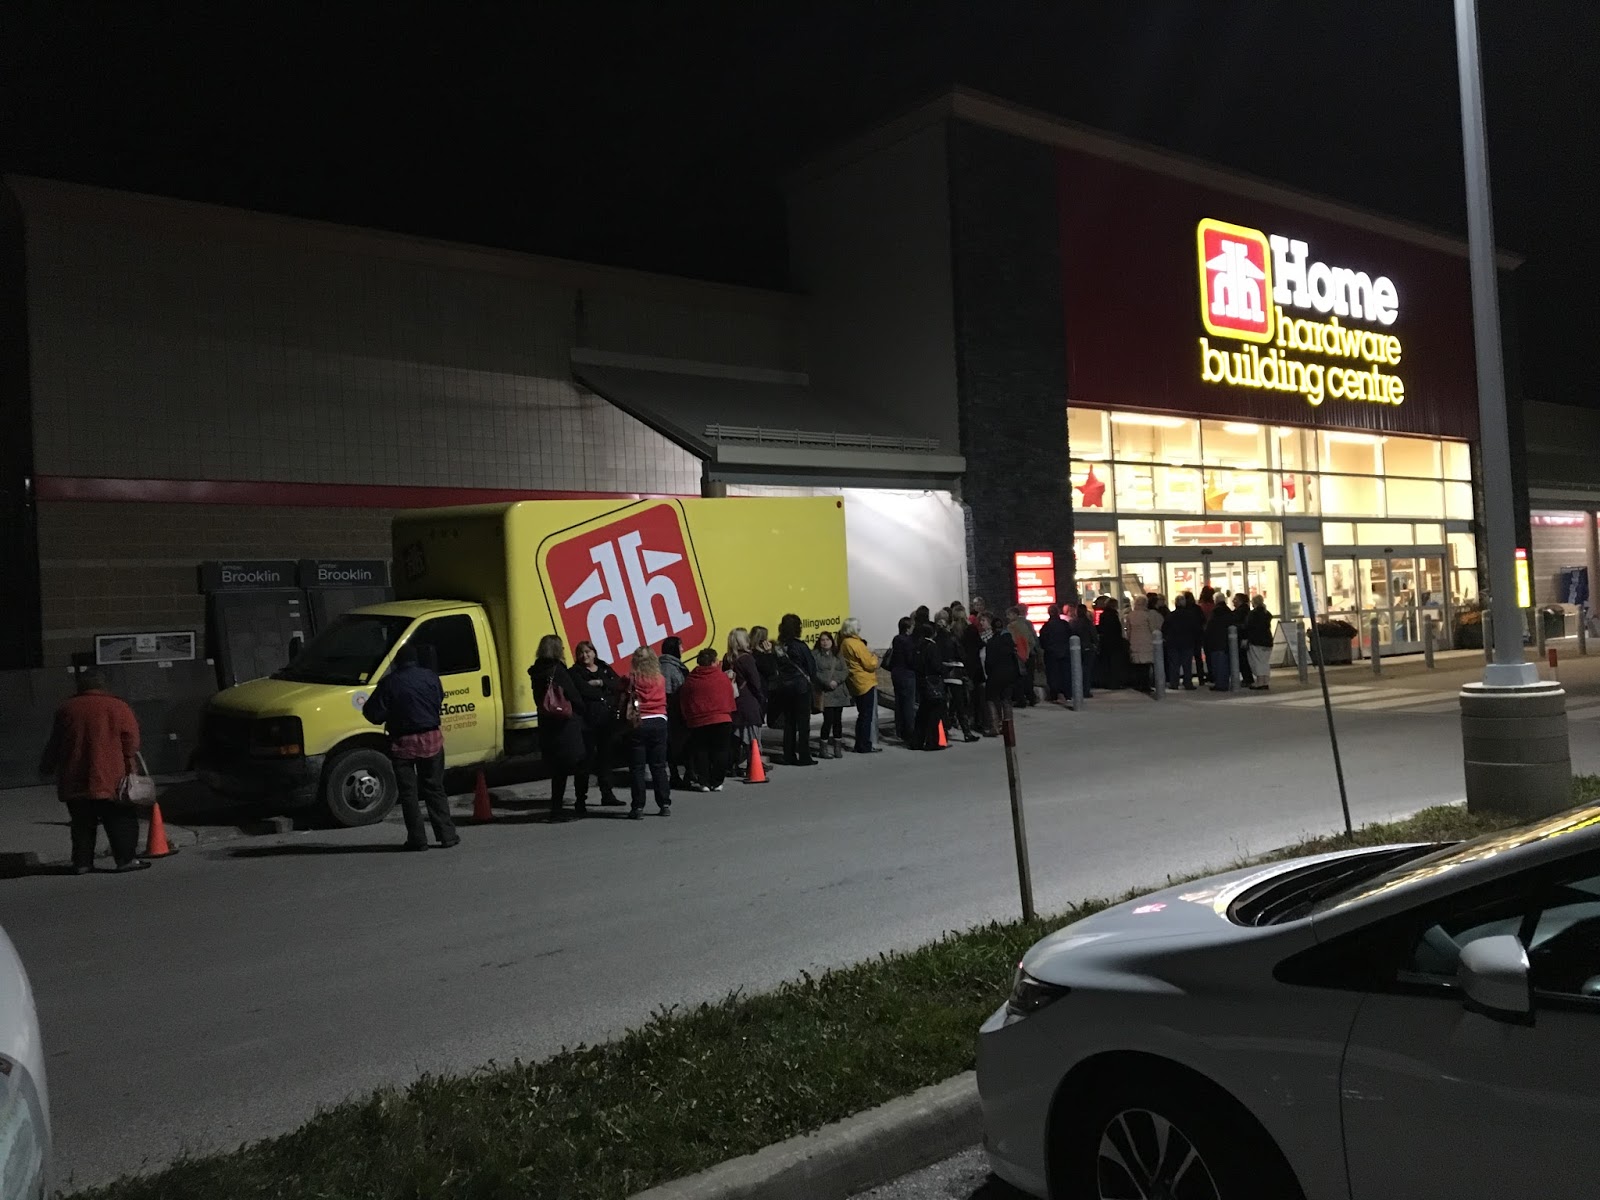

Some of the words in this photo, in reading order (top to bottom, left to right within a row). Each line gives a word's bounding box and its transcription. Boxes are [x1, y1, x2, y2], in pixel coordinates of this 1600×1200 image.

[1270, 234, 1399, 325] Home
[1275, 305, 1402, 365] hardware
[1199, 336, 1325, 406] building
[1327, 363, 1405, 406] centre
[221, 570, 280, 582] Brooklin
[318, 568, 372, 580] Brooklin
[443, 687, 470, 699] gwood
[439, 702, 476, 716] Home
[453, 720, 478, 730] centre
